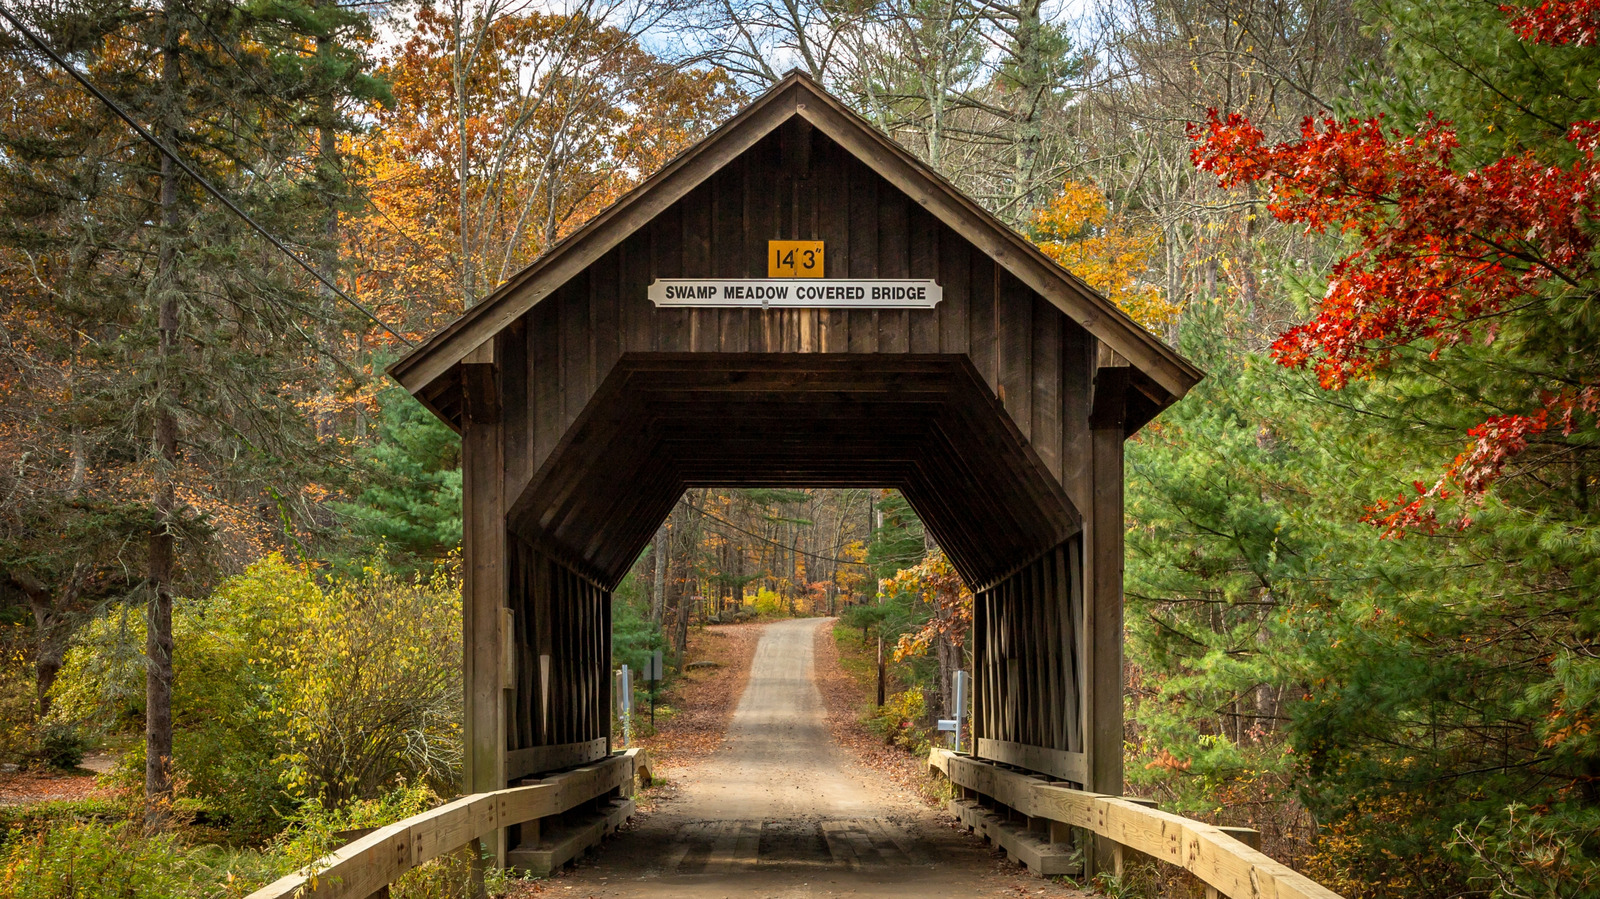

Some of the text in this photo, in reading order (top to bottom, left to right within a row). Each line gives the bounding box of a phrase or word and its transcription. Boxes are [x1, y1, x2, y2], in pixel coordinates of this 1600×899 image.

[665, 286, 926, 300] SWAMP MEADOW COVERED BRIDGE
